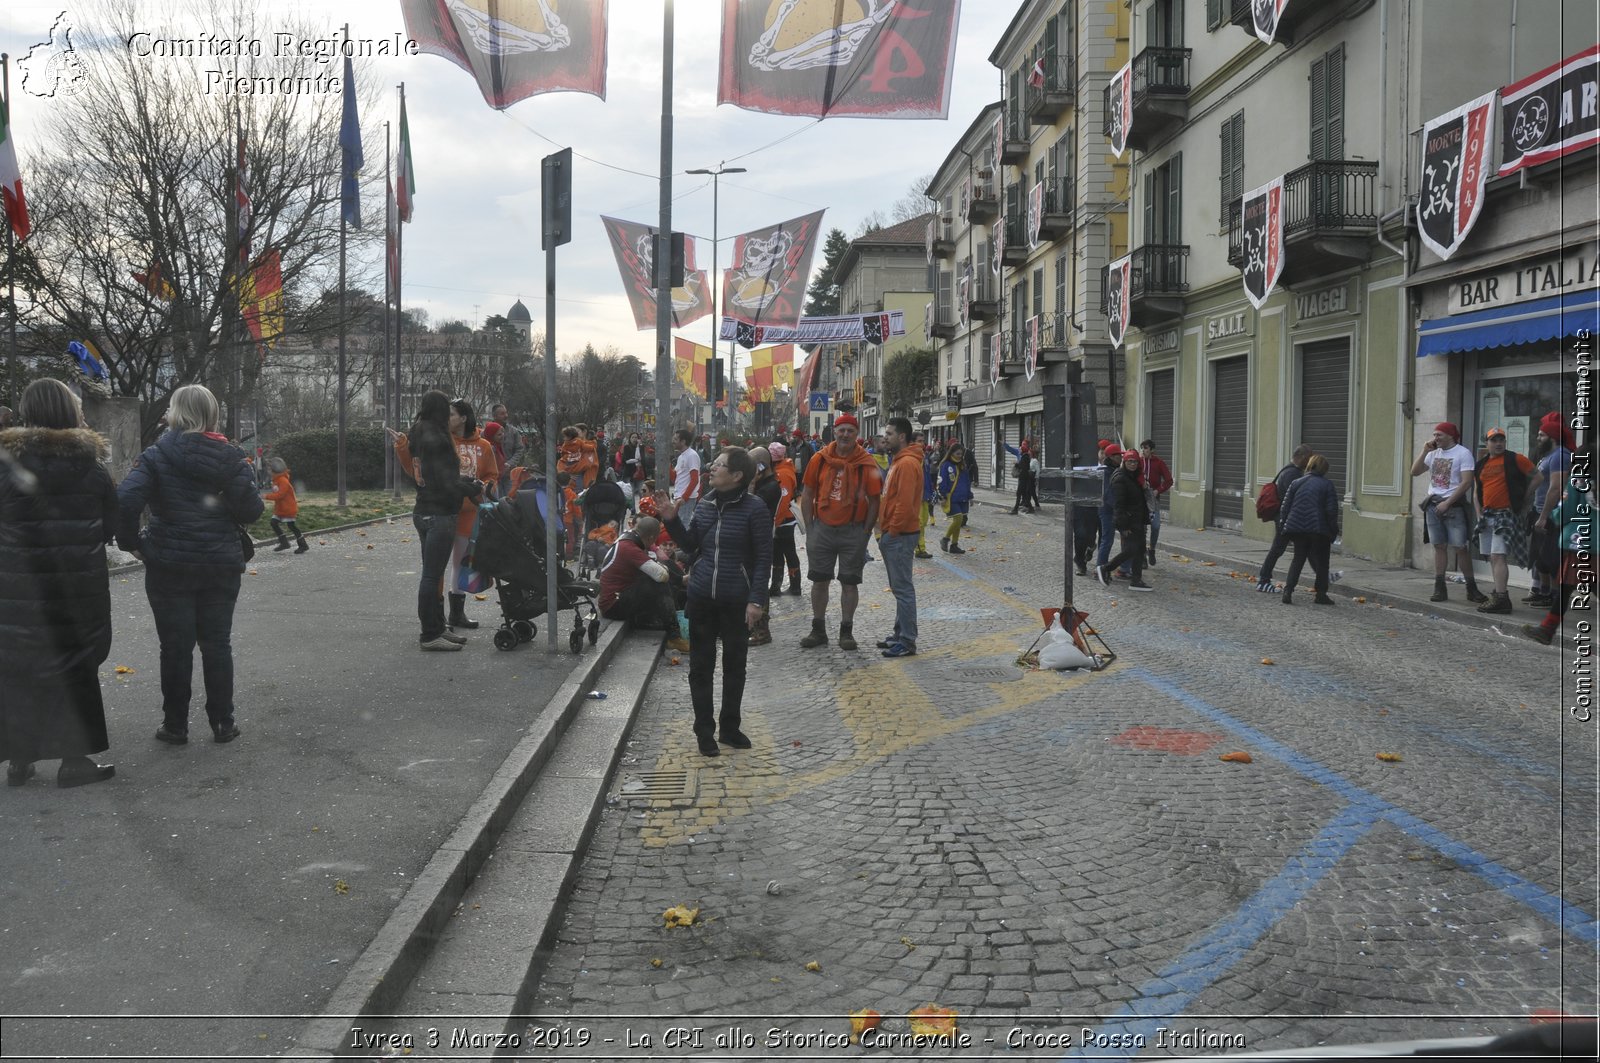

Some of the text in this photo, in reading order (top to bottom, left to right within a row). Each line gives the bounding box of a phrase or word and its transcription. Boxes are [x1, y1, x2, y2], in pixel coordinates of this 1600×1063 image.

[1427, 127, 1461, 155] MORTE
[1464, 113, 1481, 208] 1954
[1244, 201, 1265, 221] MORTE
[1269, 192, 1279, 269] 1954
[1295, 287, 1347, 320] VIAGGI
[1460, 276, 1499, 307] BAR
[1208, 313, 1247, 339] S.A.I.T.
[1142, 330, 1177, 354] TURISMO
